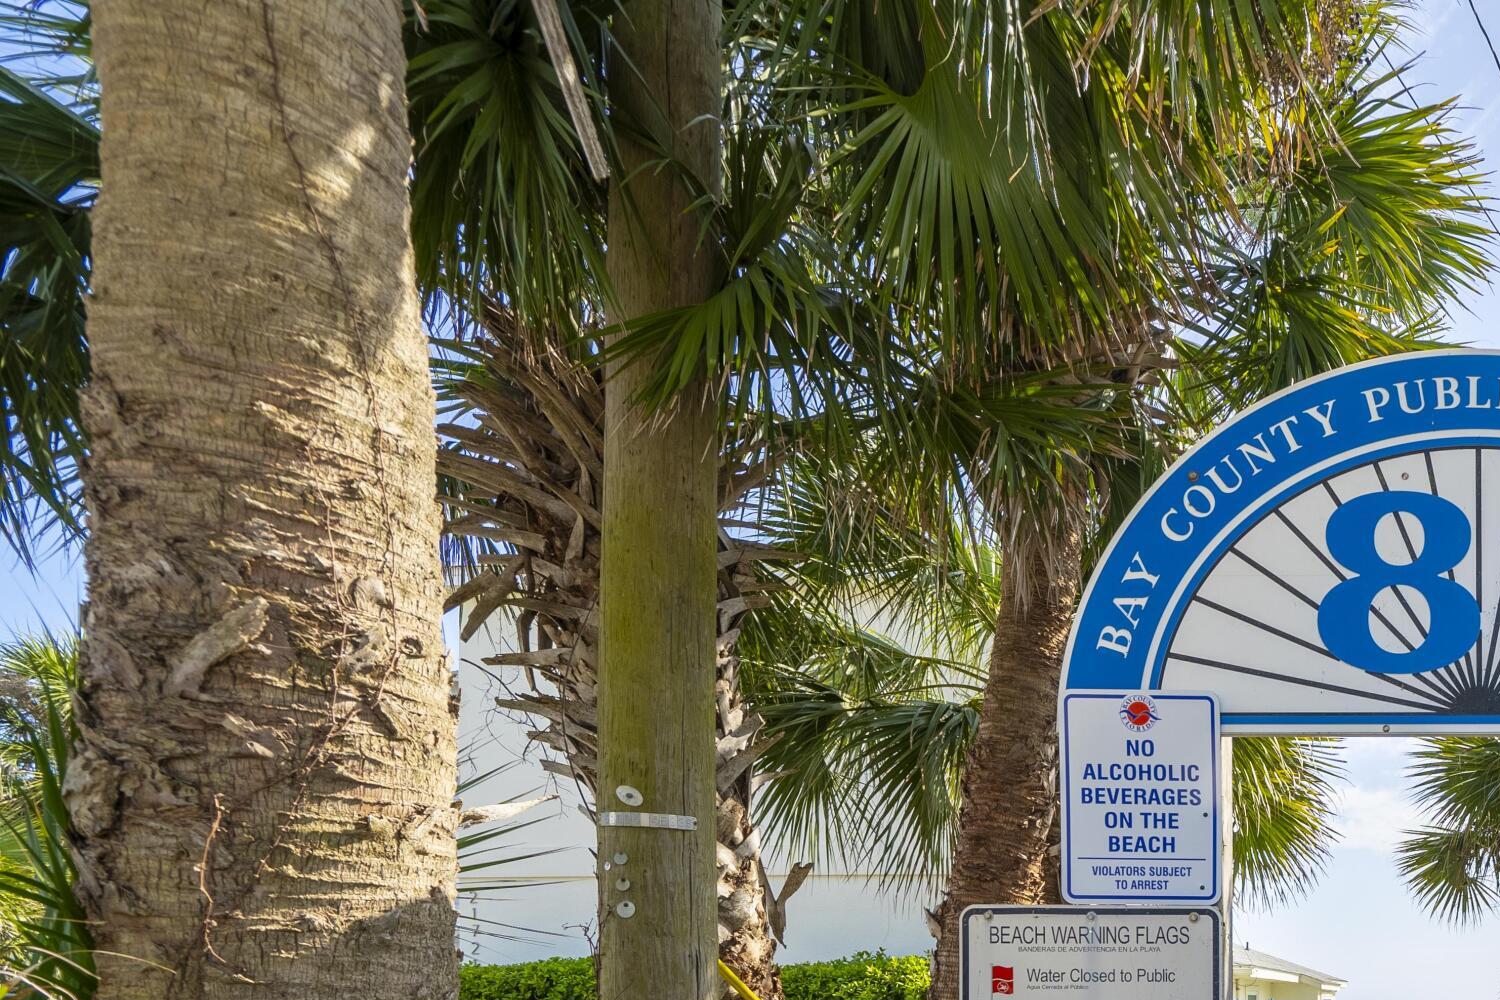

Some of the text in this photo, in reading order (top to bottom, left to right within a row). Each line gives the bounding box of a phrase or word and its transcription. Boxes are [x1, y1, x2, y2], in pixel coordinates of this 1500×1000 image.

[1096, 555, 1160, 659] BAY
[1161, 399, 1339, 542] COUNTY
[1127, 740, 1154, 756] NO
[1083, 764, 1199, 782] ALCOHOLIC
[1081, 788, 1201, 805] BEVERAGES
[1104, 812, 1179, 829] ON THE
[1109, 836, 1175, 853] BEACH
[1092, 866, 1192, 876] VIOLATORS SUBJECT
[1115, 880, 1168, 890] TO ARREST
[989, 926, 1189, 944] BEACH WARNING FLAGS
[1027, 968, 1175, 983] Water Closed to Public
